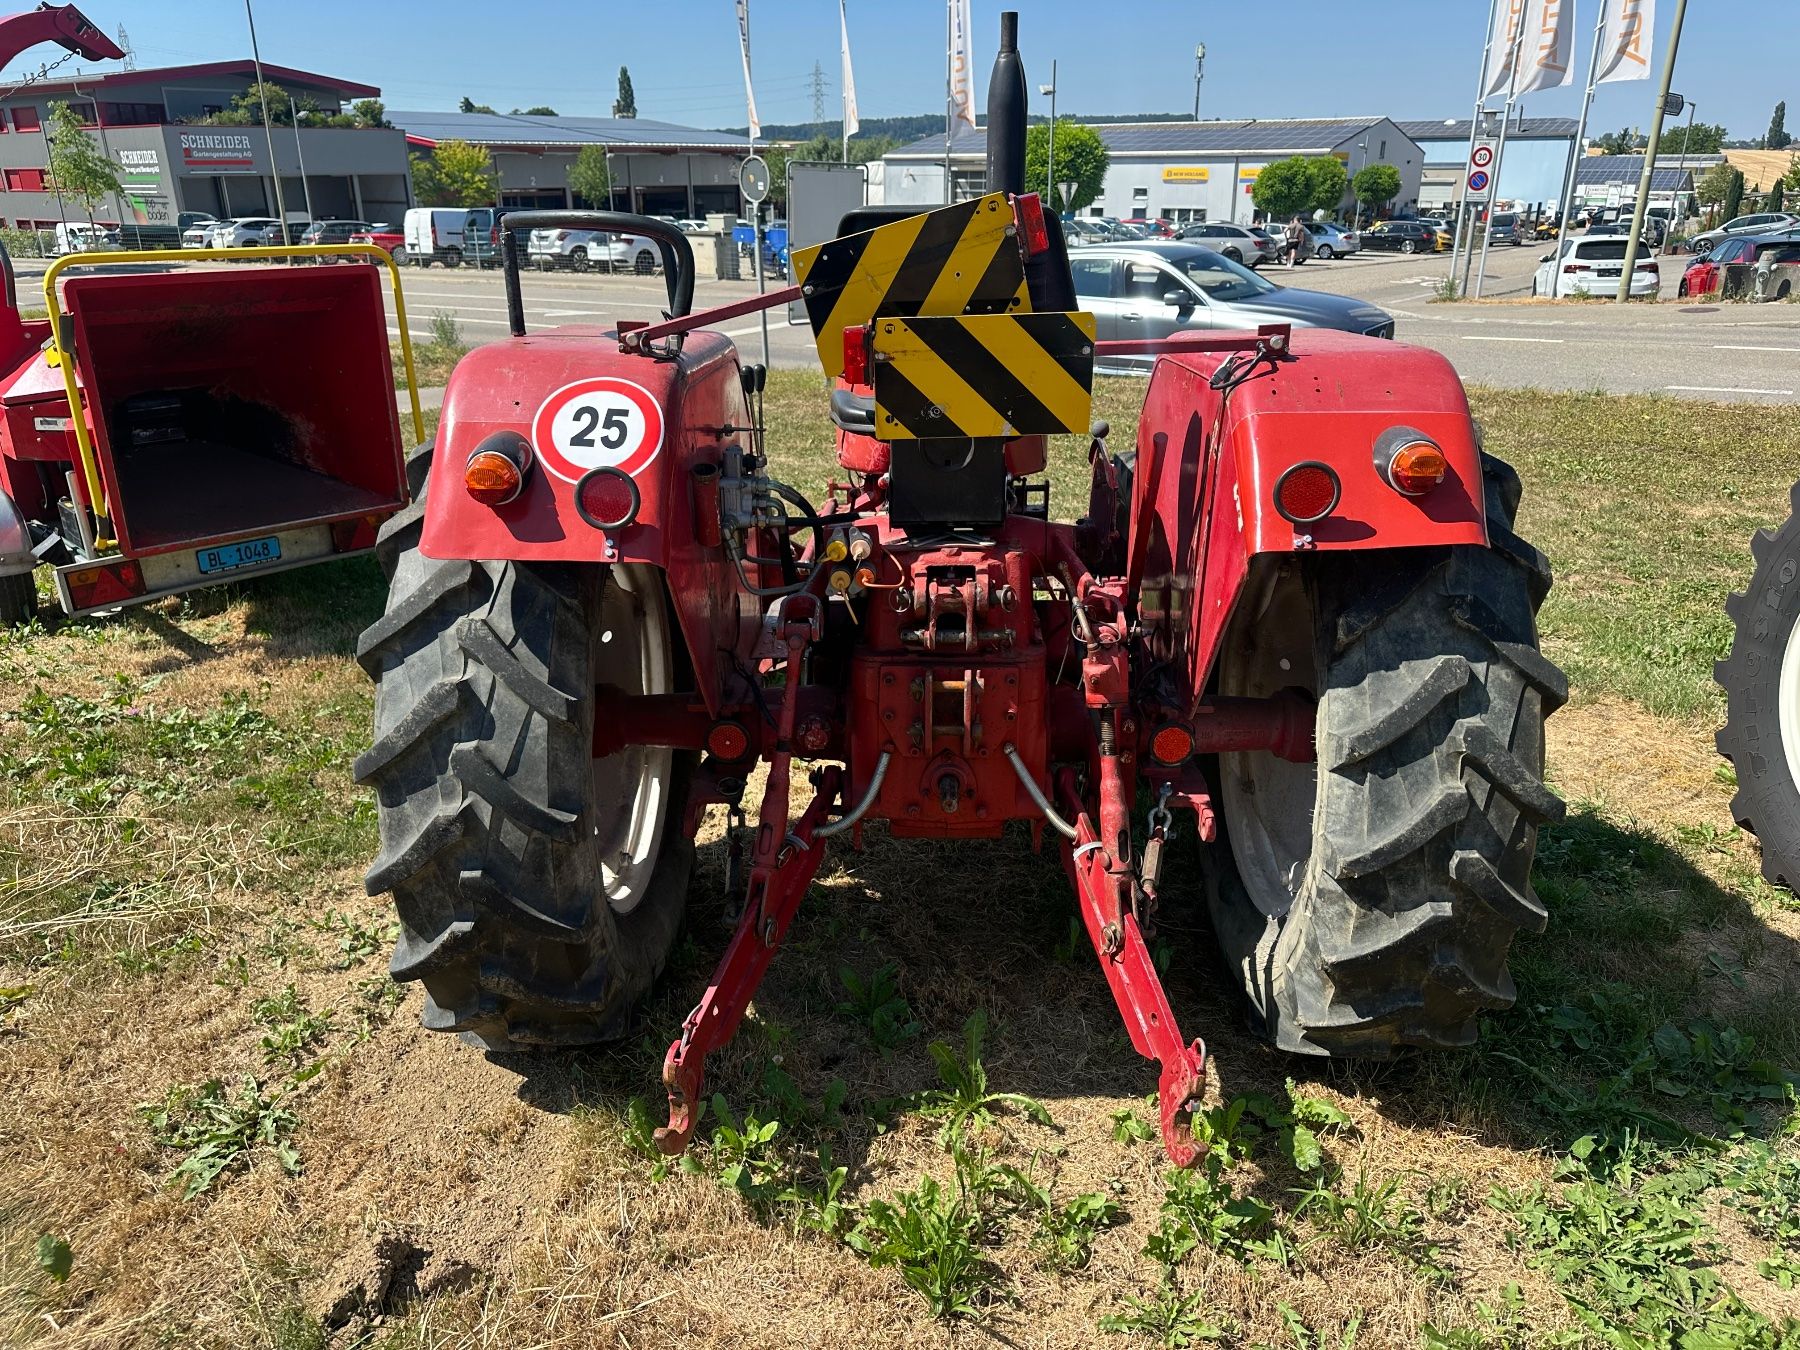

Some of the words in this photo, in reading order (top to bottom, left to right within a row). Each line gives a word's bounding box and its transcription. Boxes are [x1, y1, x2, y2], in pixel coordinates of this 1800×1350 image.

[1536, 0, 1567, 73] AUT
[180, 134, 251, 149] SCHNEIDER
[120, 150, 158, 164] SCHNEIDER
[1477, 153, 1488, 162] 30
[569, 405, 630, 450] 25
[207, 552, 226, 567] BL
[235, 542, 271, 562] 1048
